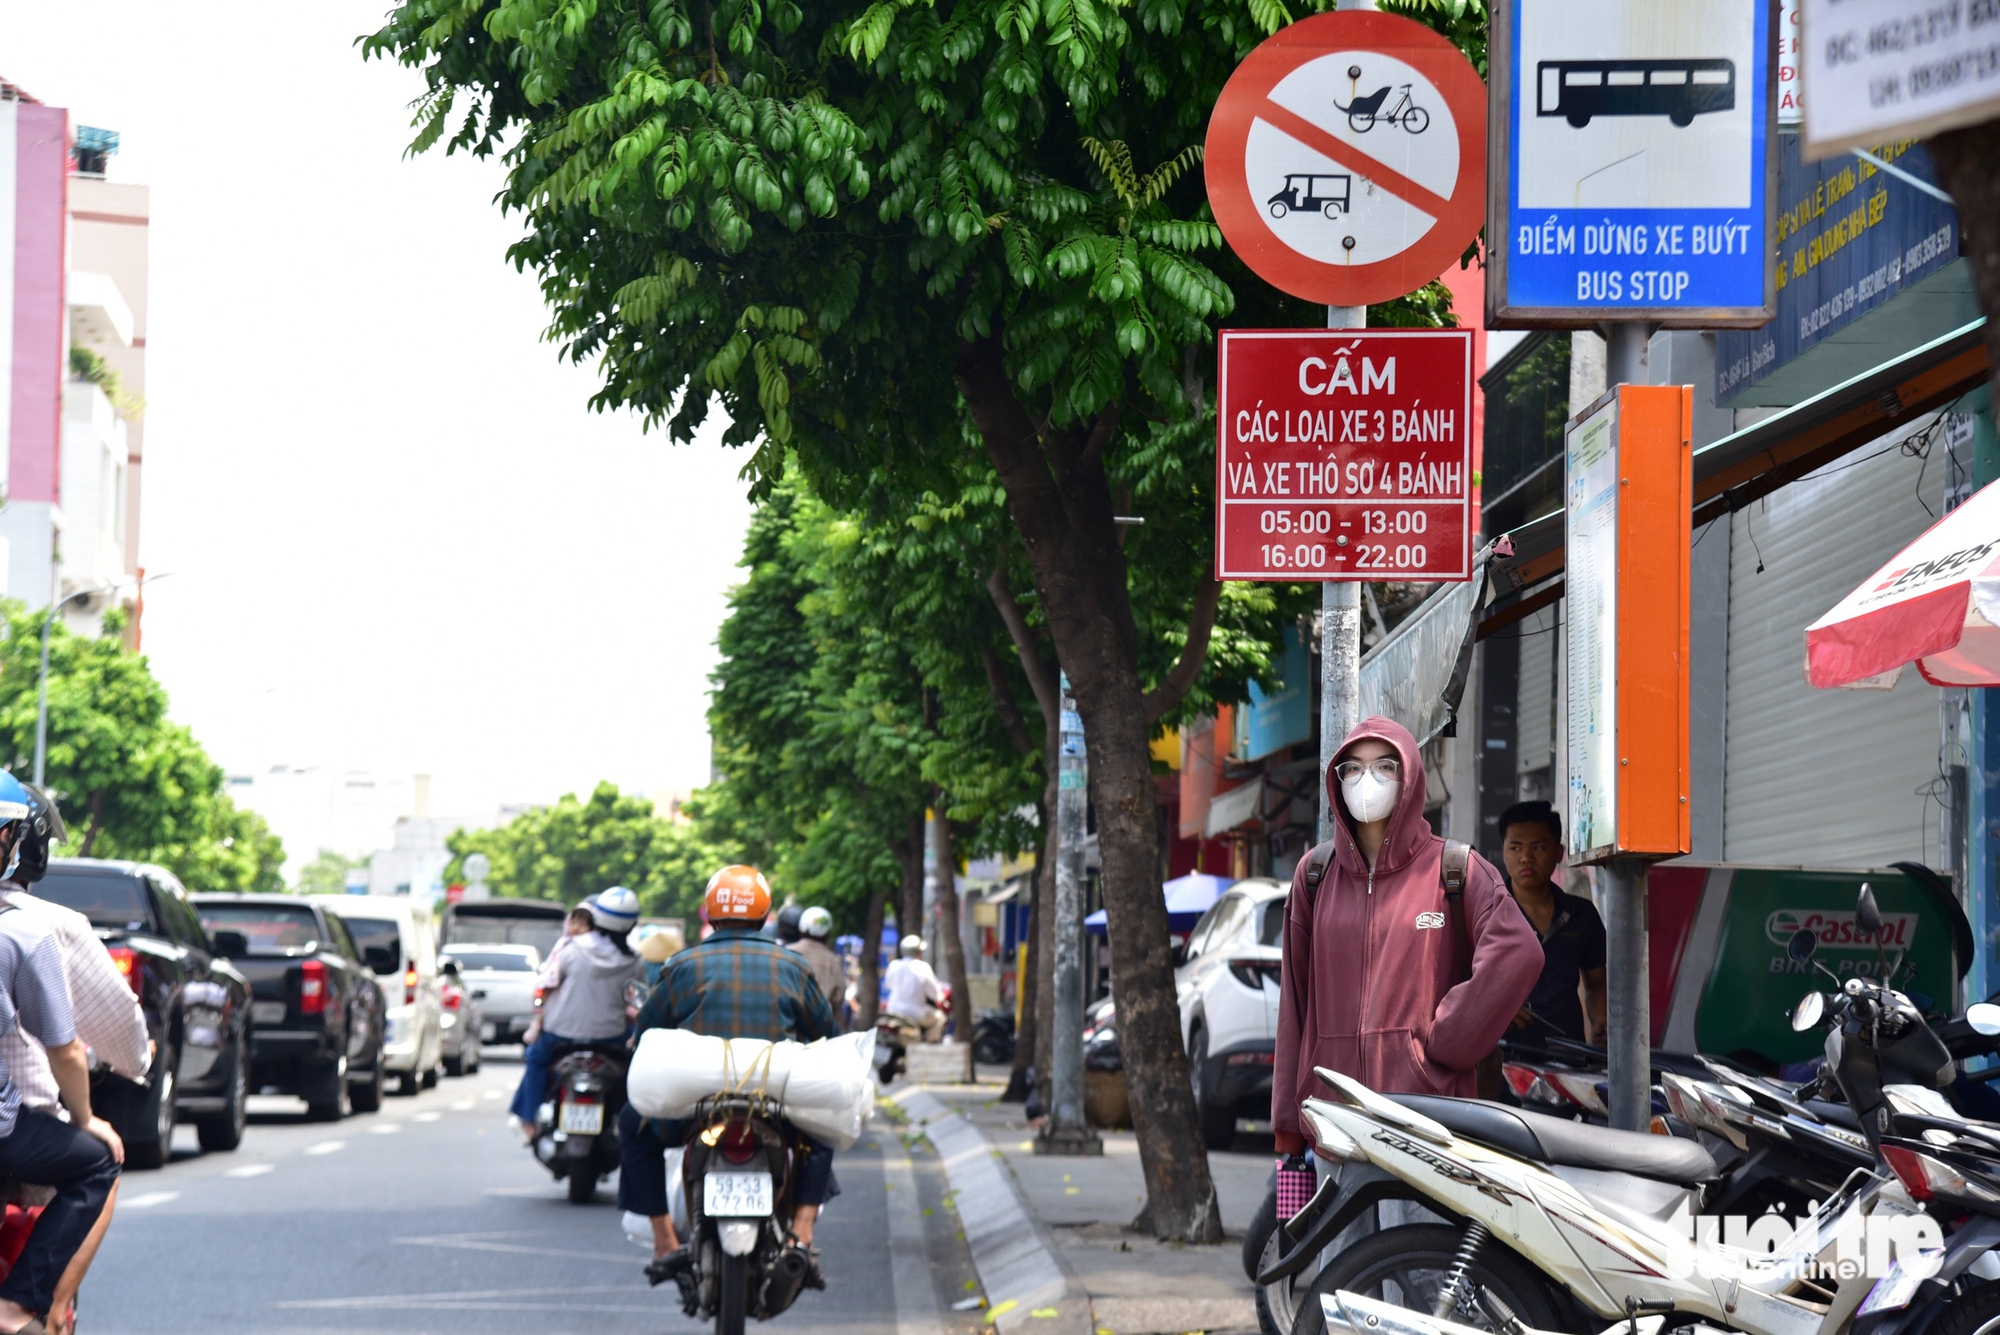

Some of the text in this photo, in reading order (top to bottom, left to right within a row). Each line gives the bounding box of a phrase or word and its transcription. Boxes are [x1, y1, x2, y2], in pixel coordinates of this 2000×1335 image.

[1826, 166, 1856, 208] TRANG
[1518, 214, 1751, 256] ĐIỂM DỪNG XE BUÝT
[1823, 217, 1848, 262] DỤNG
[1577, 271, 1689, 300] BUS STOP
[1299, 339, 1396, 395] CẤM
[1236, 399, 1454, 450] CÁC LOẠI XE 3 BÁNH
[1228, 452, 1461, 495] VÀ XE THÔ SƠ 4 BÁNH
[1260, 510, 1331, 534] 05:00
[1362, 510, 1427, 534] 13:00
[1261, 545, 1326, 568] 16:00
[1356, 544, 1427, 568] 22:00
[1893, 543, 1993, 588] ENEOS
[1768, 957, 1828, 975] BIKE
